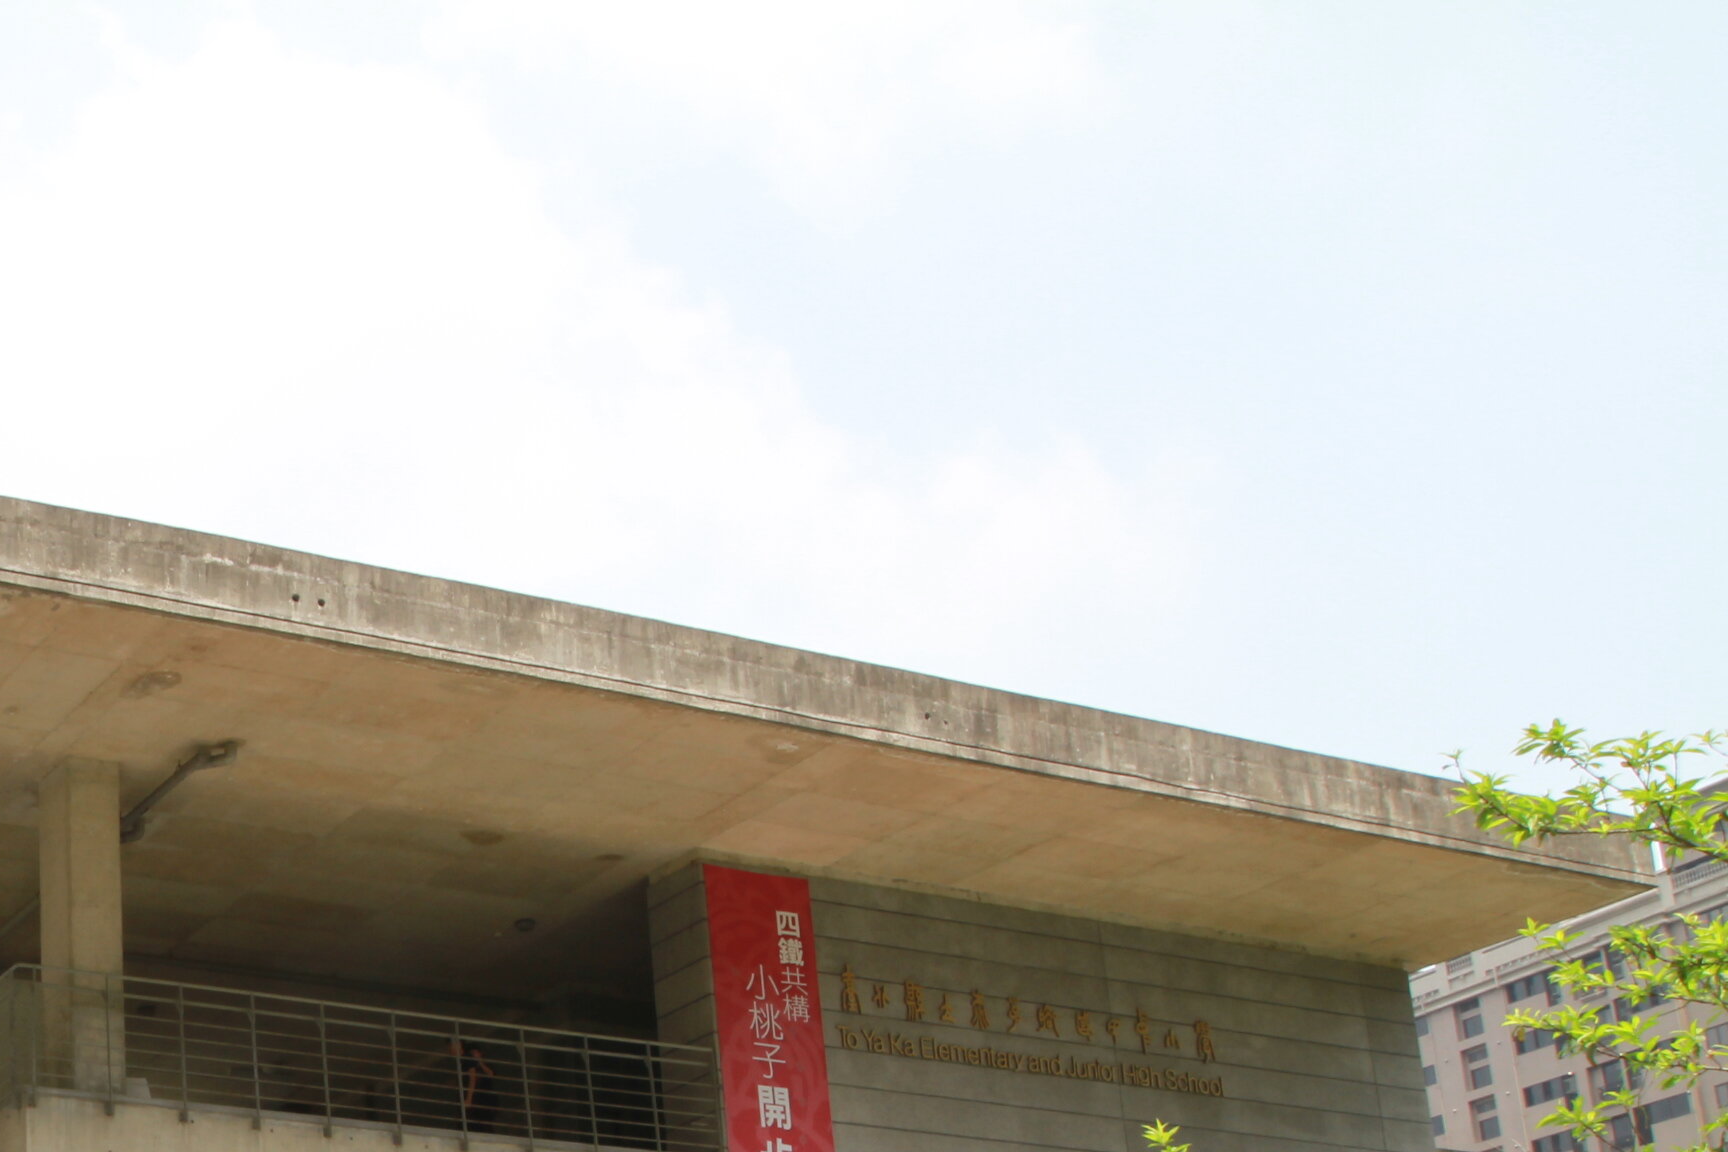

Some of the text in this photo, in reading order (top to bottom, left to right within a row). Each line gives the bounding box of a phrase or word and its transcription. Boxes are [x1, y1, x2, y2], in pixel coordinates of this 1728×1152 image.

[775, 910, 811, 1024] 四鐵共構
[836, 1024, 1225, 1098] To Ya Ka Elementary and Junior High School
